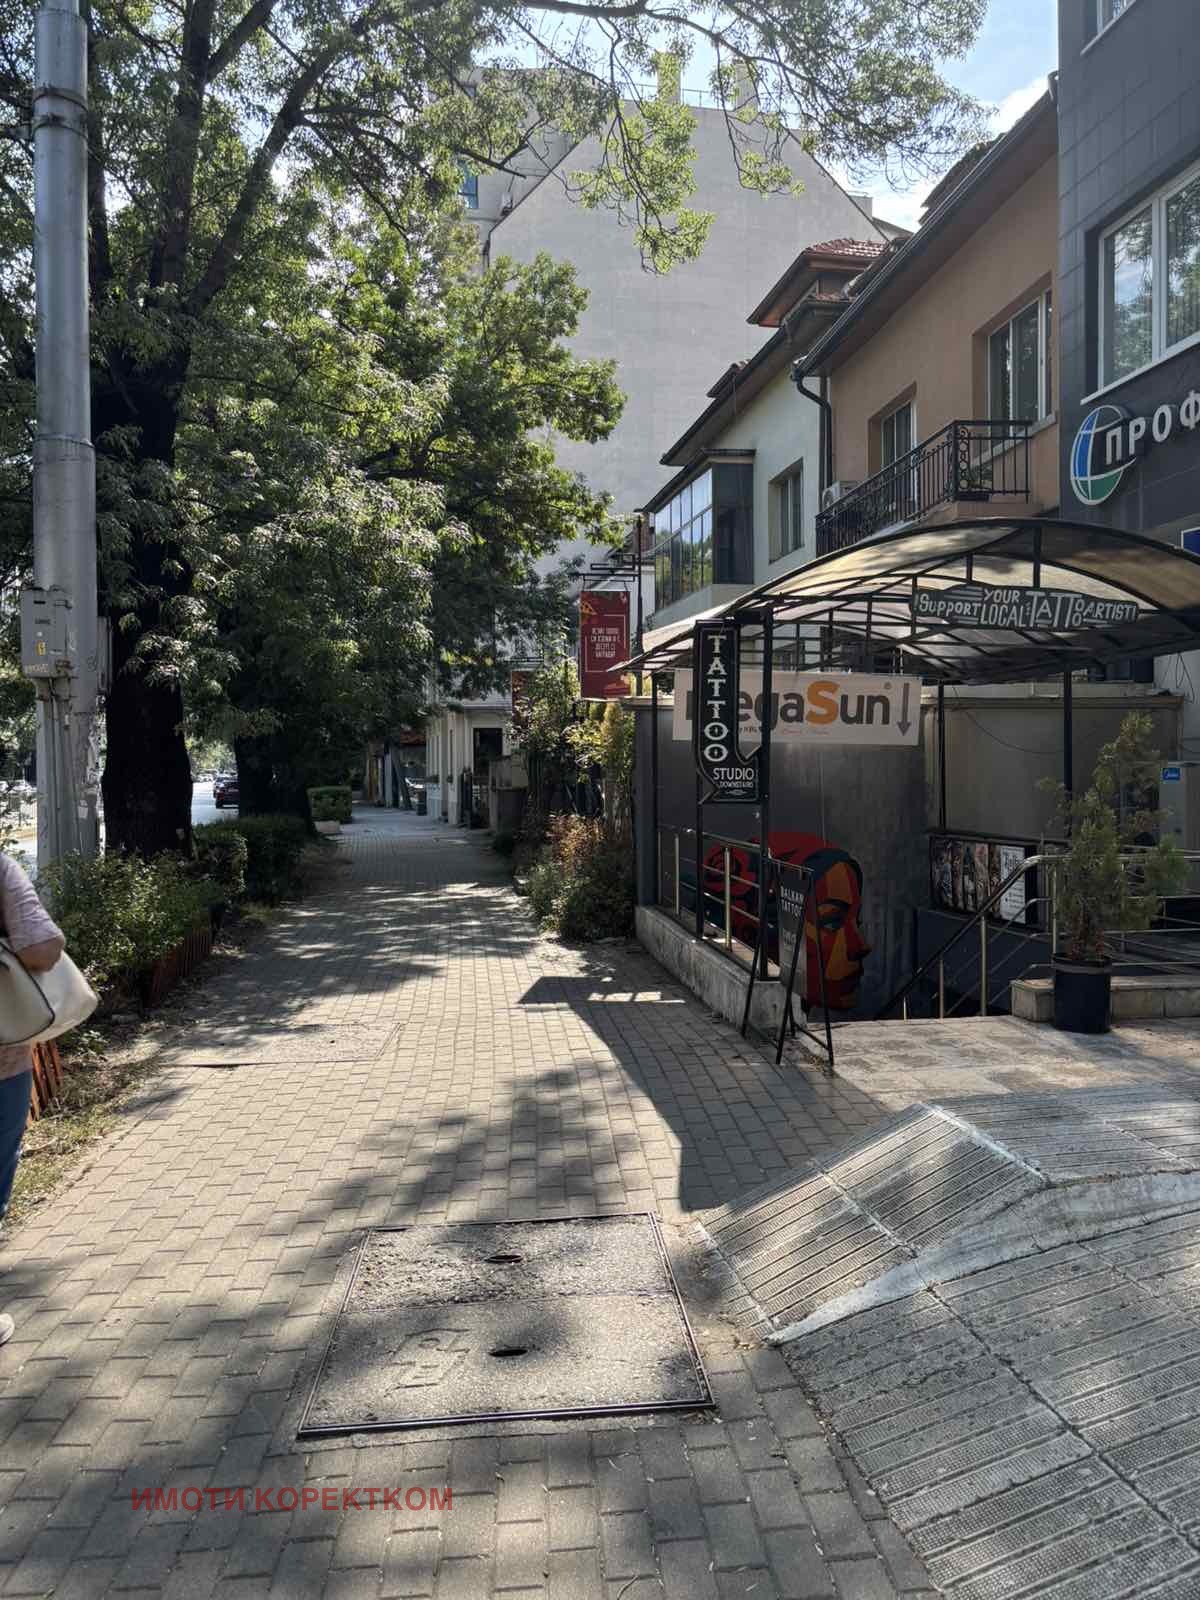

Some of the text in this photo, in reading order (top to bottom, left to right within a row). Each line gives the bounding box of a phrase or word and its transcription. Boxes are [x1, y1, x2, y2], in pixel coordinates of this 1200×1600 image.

[983, 588, 1020, 603] YOUR
[980, 603, 1026, 627] LOCAL
[703, 635, 729, 762] TATTOO
[713, 767, 754, 780] STUDIO
